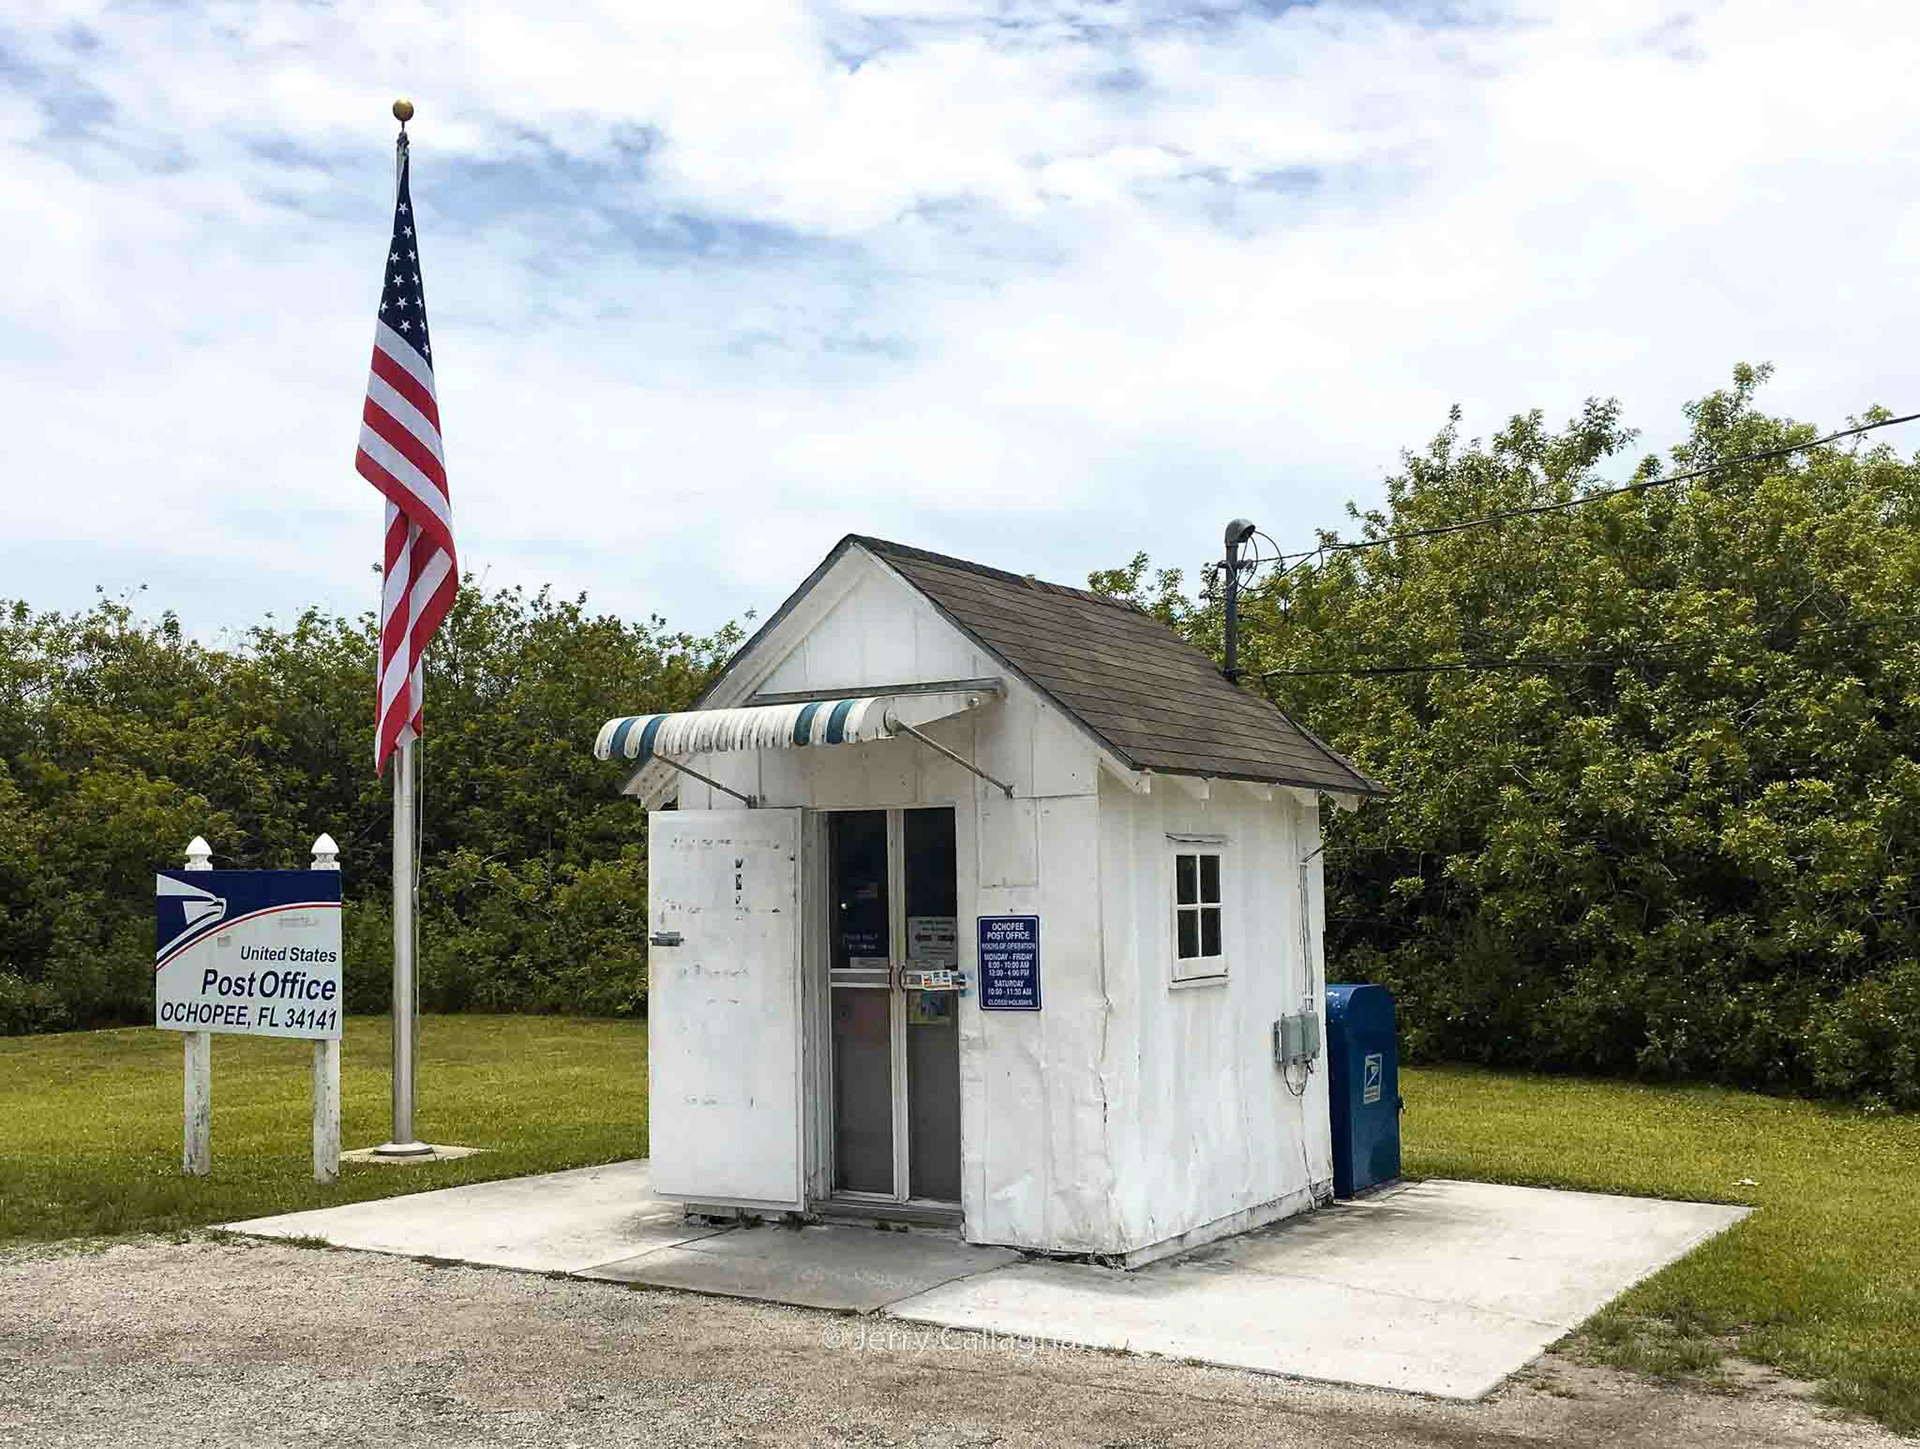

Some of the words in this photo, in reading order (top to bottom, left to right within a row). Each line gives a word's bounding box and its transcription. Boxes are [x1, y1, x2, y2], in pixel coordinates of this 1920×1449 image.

[240, 946, 286, 961] United
[289, 946, 337, 962] States
[201, 968, 255, 997] Post
[259, 970, 337, 1000] Office
[161, 1002, 252, 1028] OCHOPEE,
[258, 1007, 279, 1027] FL
[285, 1008, 337, 1030] 34141
